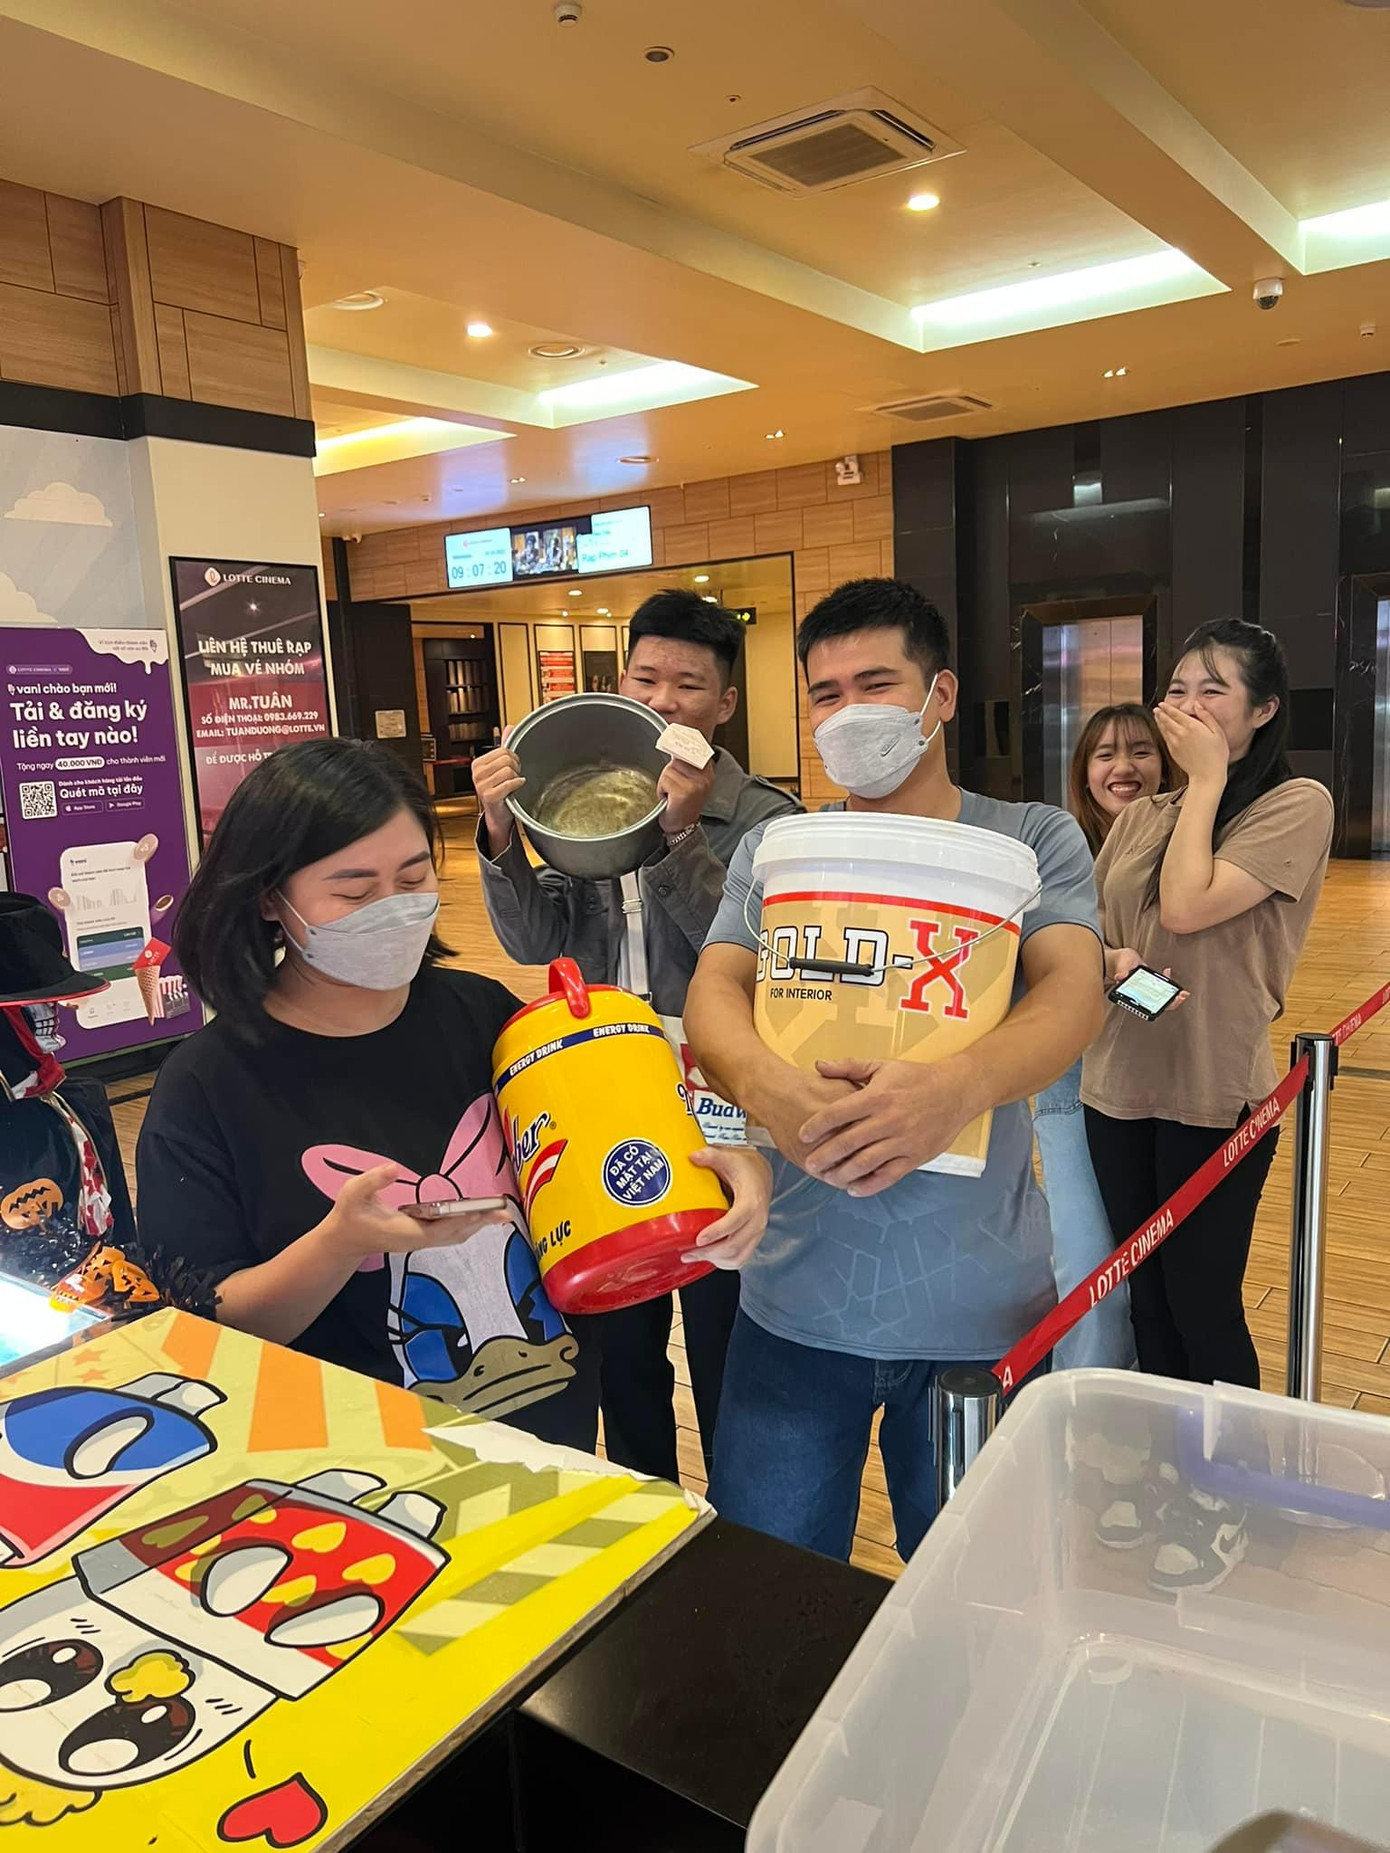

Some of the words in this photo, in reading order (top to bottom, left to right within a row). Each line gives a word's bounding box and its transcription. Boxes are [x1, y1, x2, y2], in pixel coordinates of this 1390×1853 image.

[222, 574, 253, 584] LOTTE
[254, 575, 292, 585] CINEMA
[198, 636, 226, 654] LIÊN
[230, 636, 249, 657] HỆ
[250, 637, 285, 654] THUÊ
[286, 639, 312, 657] RẠP
[210, 662, 242, 676] MUA
[244, 658, 263, 675] VÉ
[265, 659, 305, 675] NHÓM
[16, 684, 42, 695] vani
[43, 682, 71, 694] chào
[72, 683, 94, 696] bạn
[95, 682, 118, 694] mới!
[10, 700, 45, 722] Tải
[49, 702, 65, 721] &
[69, 700, 122, 723] đăng
[124, 699, 148, 722] ký
[264, 711, 319, 723] 0983.669.229
[13, 726, 52, 749] liền
[56, 730, 90, 750] tay
[95, 725, 138, 745] nào!
[196, 729, 225, 739] EMAIL:
[226, 724, 326, 737] TUANDUONG@LOTTE.VN
[36, 762, 55, 771] ngay
[57, 759, 86, 769] 40.000
[106, 758, 120, 766] cho
[220, 752, 247, 765] ĐƯỢC
[59, 788, 87, 799] Quét
[88, 785, 105, 796] mã
[107, 784, 122, 798] tại
[124, 783, 143, 796] đây
[769, 987, 784, 999] FOR
[785, 988, 833, 1001] INTERIOR
[593, 1023, 627, 1038] ENERGY
[627, 1023, 651, 1034] DRINK
[509, 1051, 537, 1077] ENERGY
[536, 1039, 563, 1059] DRINK
[512, 1111, 550, 1176] ber
[1223, 1126, 1250, 1168] LOTTE
[609, 1158, 627, 1177] ĐÃ
[623, 1144, 639, 1162] CÓ
[615, 1168, 639, 1190] MẶT
[636, 1150, 654, 1168] TẠI
[622, 1179, 646, 1201] VIỆT
[643, 1158, 665, 1182] NAM
[550, 1220, 572, 1247] LỰC
[1089, 1253, 1131, 1308] LOTTE
[1130, 1208, 1174, 1267] CINEMA
